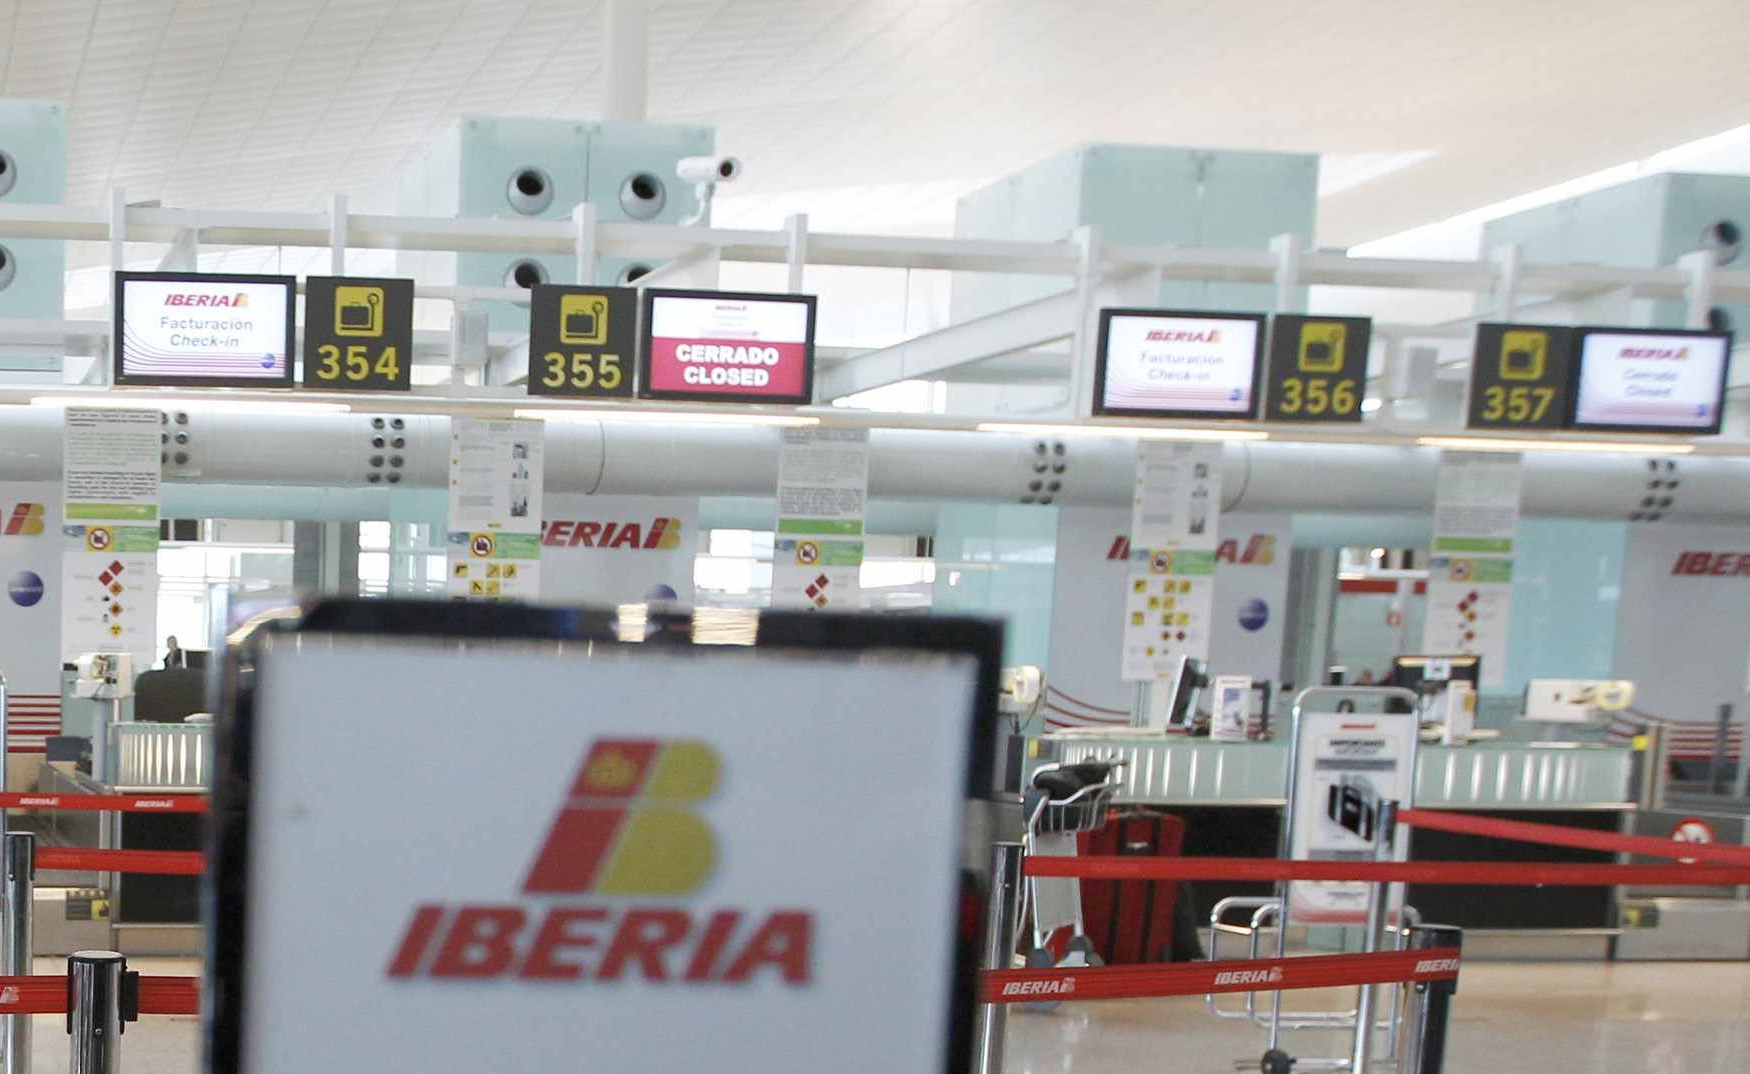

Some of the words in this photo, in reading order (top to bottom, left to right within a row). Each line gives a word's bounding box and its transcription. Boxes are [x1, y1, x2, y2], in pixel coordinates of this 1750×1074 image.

[164, 294, 230, 307] IBERIA
[170, 335, 239, 348] Check-in
[1146, 330, 1208, 342] IBERIA
[316, 344, 399, 381] 354
[675, 344, 780, 365] CERRADO
[542, 351, 622, 390] 355
[683, 366, 770, 387] CLOSED
[1279, 377, 1356, 414] 356
[1481, 385, 1554, 422] 357
[541, 520, 641, 549] ERIA
[385, 904, 816, 984] IBERIA
[1002, 981, 1060, 995] IBERIA
[1214, 971, 1269, 985] IBERIA
